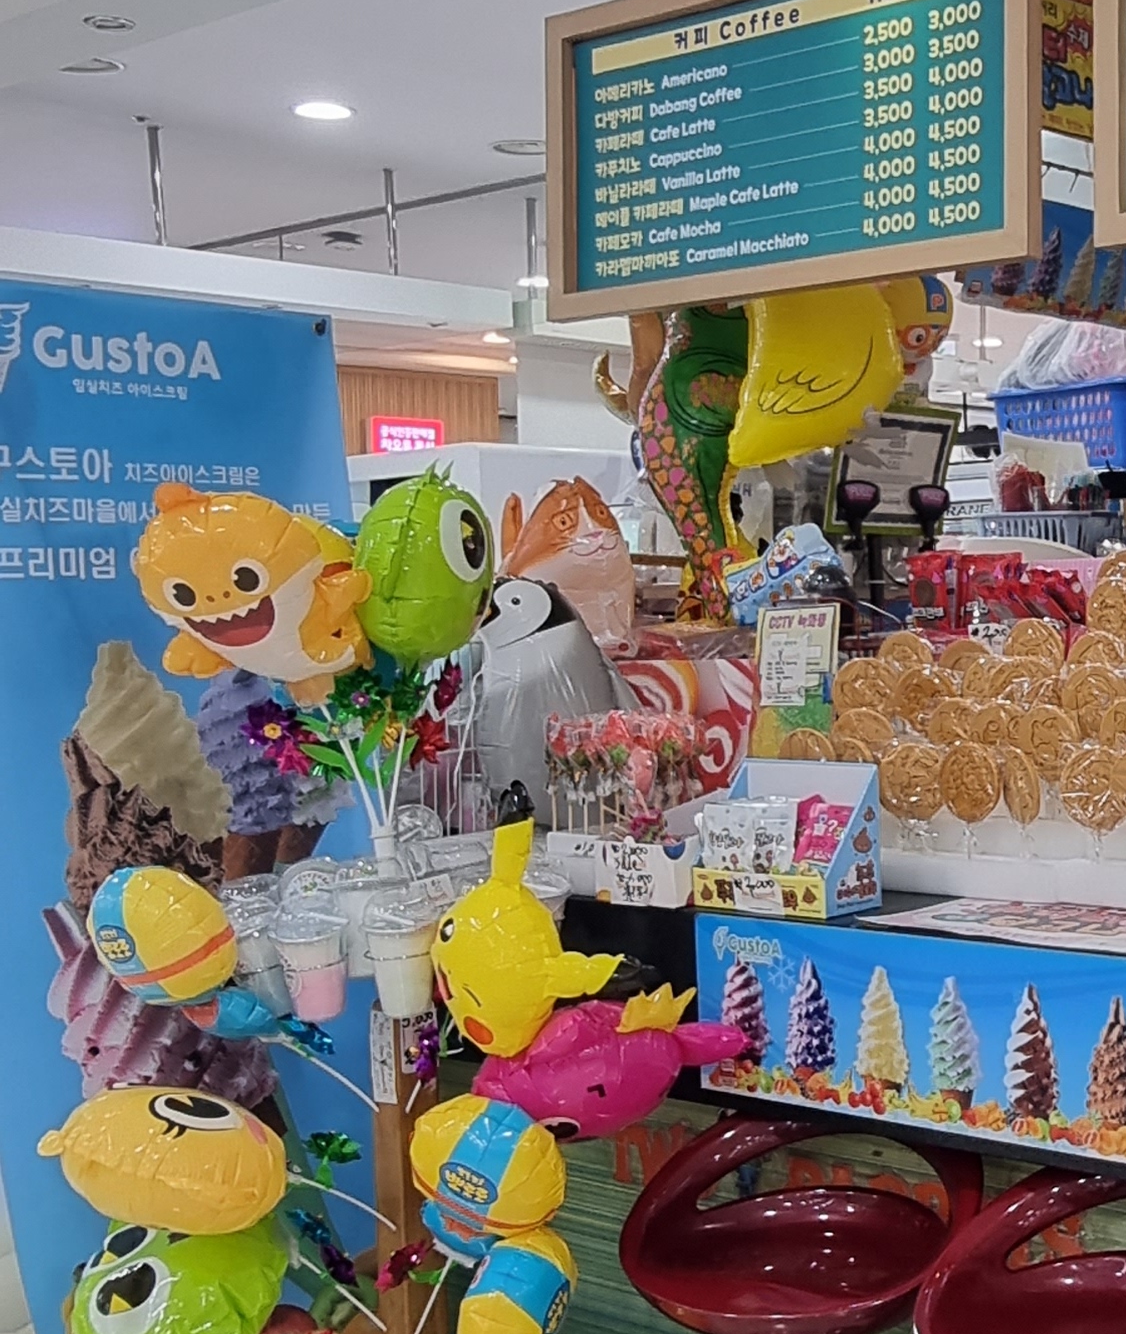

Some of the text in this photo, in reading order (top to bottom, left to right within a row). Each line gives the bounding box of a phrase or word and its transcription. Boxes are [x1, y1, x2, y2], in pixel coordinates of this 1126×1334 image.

[595, 0, 981, 103] 아메리카노 Americano 2,500 3,000
[674, 27, 708, 49] 커피
[719, 8, 800, 40] Coffee
[595, 29, 979, 130] 다방커피 Dabang Coffee 3,000 3,500
[651, 125, 680, 143] Cafe
[681, 118, 716, 137] Latte
[864, 73, 913, 100] 3,500
[929, 57, 983, 87] 4,000
[595, 86, 983, 178] 카푸치노 Cappuccino 3,500 4,000
[662, 171, 704, 191] Vanilla
[706, 165, 741, 183] Latte
[864, 128, 915, 155] 4,000
[929, 115, 980, 143] 4,500
[595, 172, 980, 253] 카페모카 Cafe Mocha 4,000 4,500
[689, 192, 727, 212] Maple
[729, 185, 760, 205] Cafe
[762, 180, 799, 199] Latte
[864, 155, 915, 183] 4,000
[929, 143, 980, 172] 4,500
[686, 200, 980, 263] Caramel Macchiato 4,000 4,500
[125, 462, 260, 486] 치즈아이스크림은
